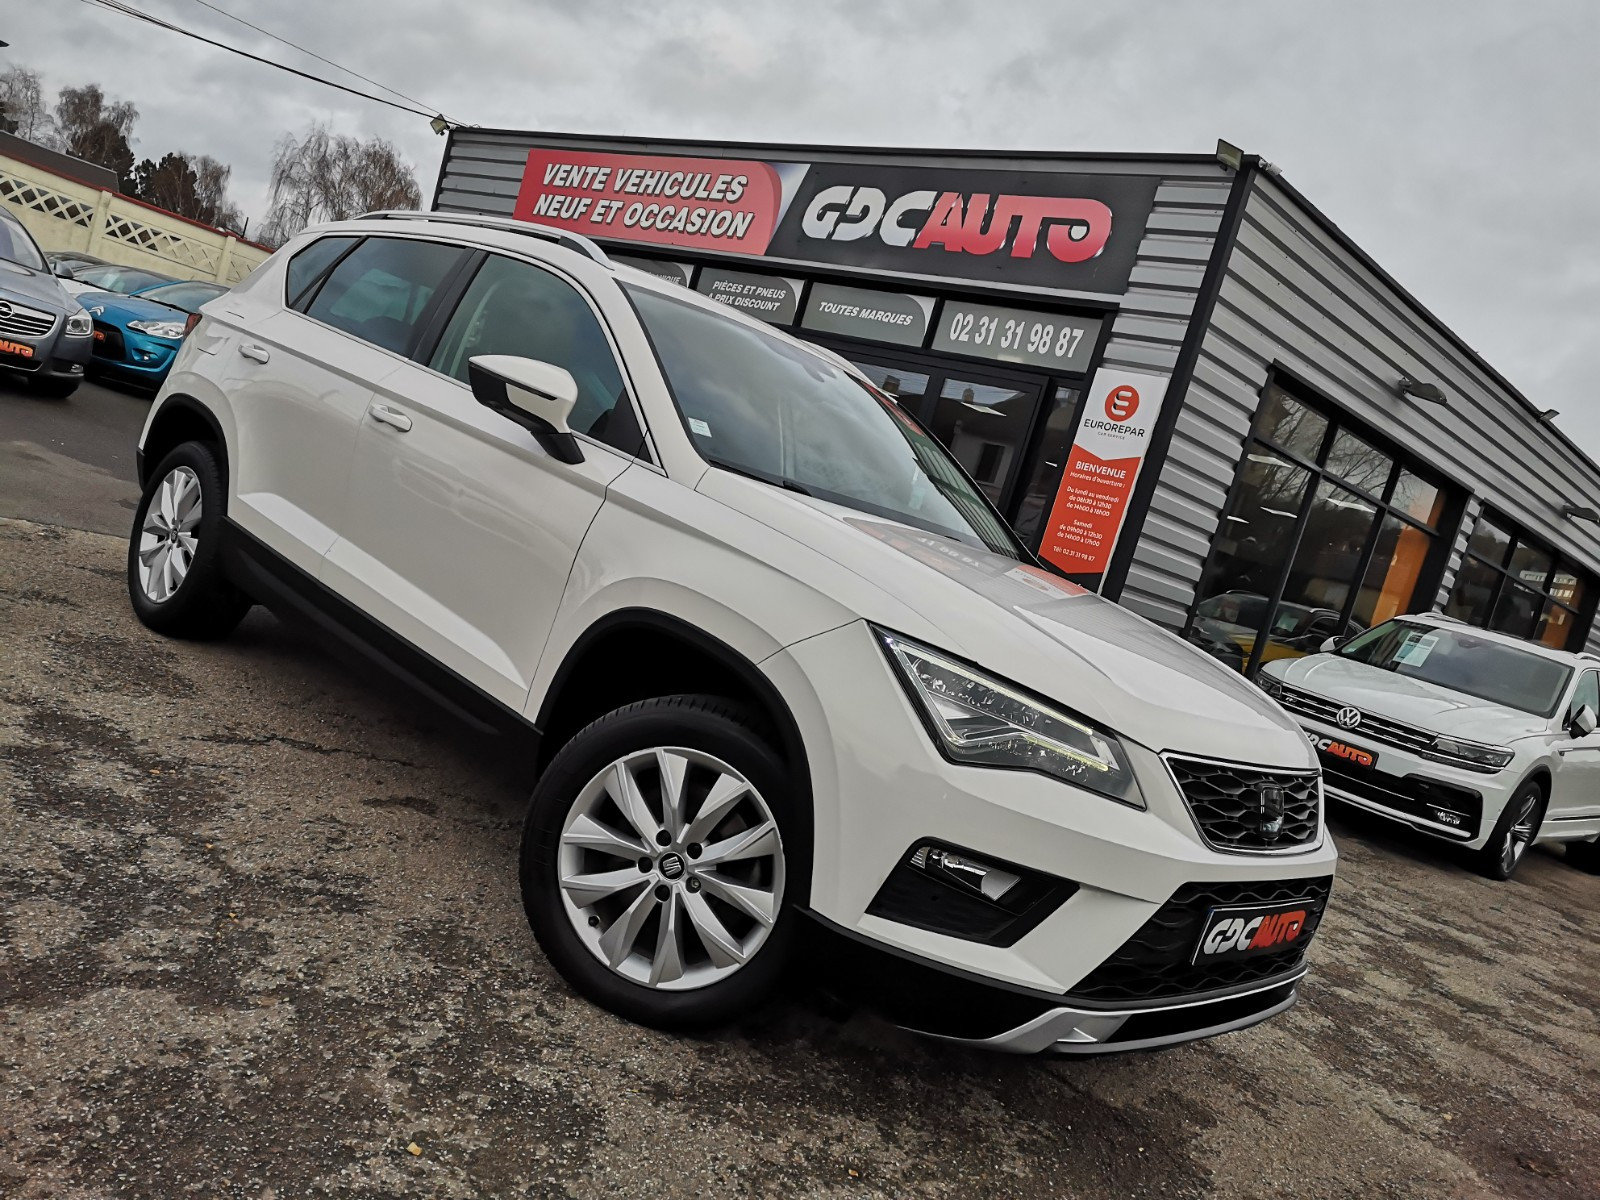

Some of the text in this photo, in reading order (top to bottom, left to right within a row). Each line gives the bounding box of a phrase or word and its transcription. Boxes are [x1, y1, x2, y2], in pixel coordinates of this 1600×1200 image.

[542, 163, 748, 201] VENTE VEHICULES
[532, 194, 754, 238] NEUF ET OCCASION
[712, 279, 787, 300] PIÈCES ET PNEUS
[714, 294, 734, 305] PRIX
[733, 298, 781, 312] DISCOUNT
[818, 301, 914, 326] TOUTES MARQUES
[949, 312, 1085, 358] 02 31 31 98 87
[1083, 418, 1146, 438] EUROREPAR
[1069, 471, 1092, 481] Horaires
[1075, 460, 1127, 479] BIENVENUE
[1066, 485, 1075, 493] Du
[1074, 487, 1088, 496] lundi
[1095, 492, 1120, 504] vendredi
[1073, 519, 1093, 529] Samedi
